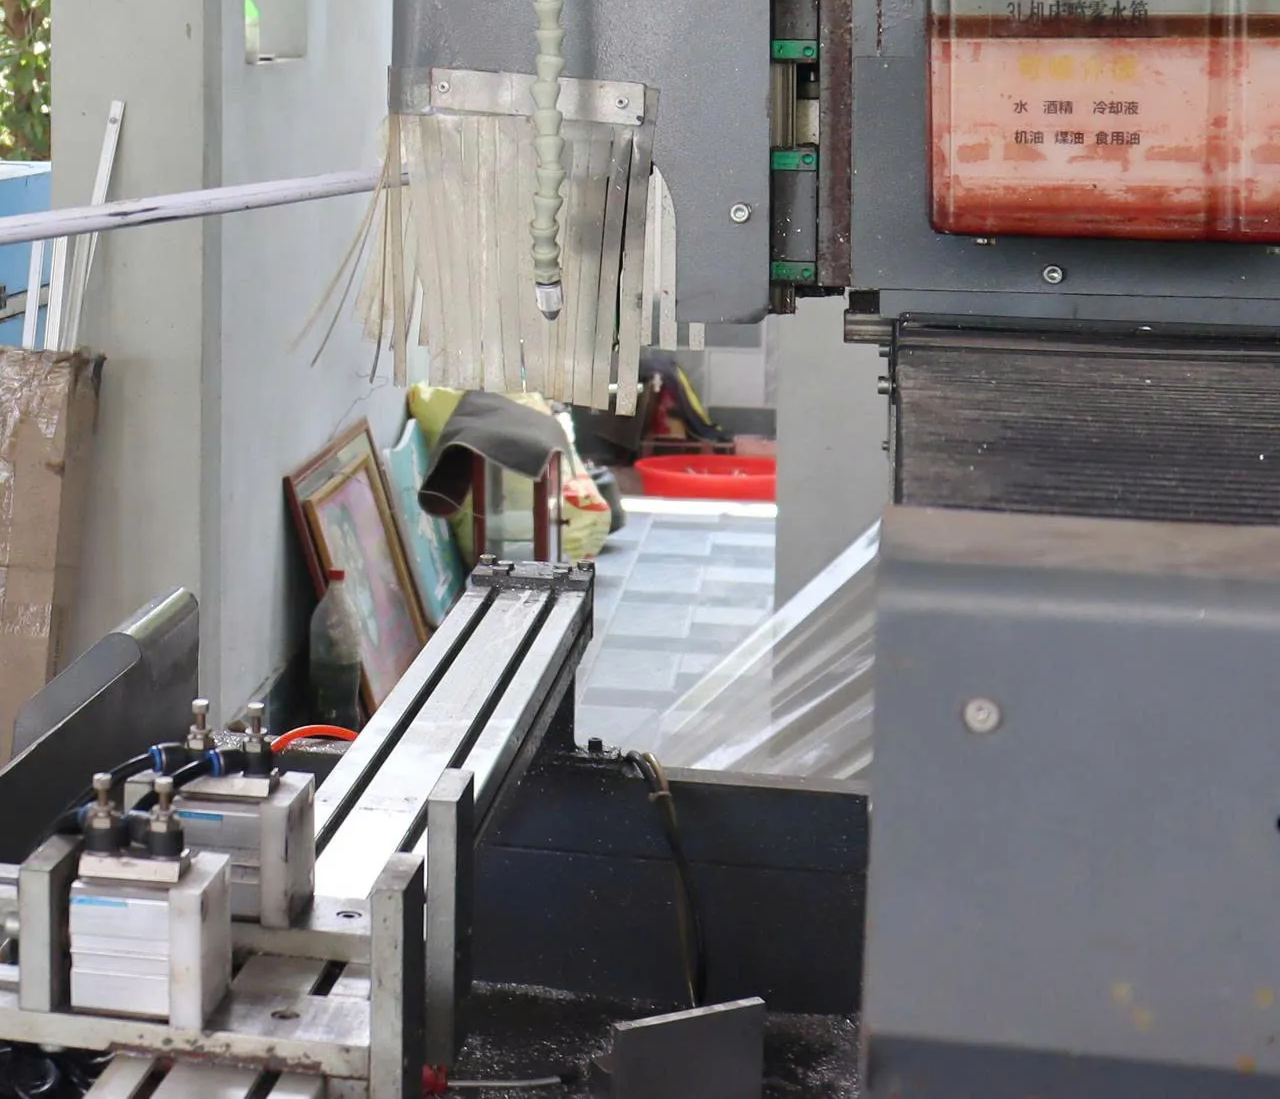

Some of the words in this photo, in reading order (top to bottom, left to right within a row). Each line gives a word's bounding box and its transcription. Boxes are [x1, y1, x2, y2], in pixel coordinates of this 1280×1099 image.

[1013, 100, 1028, 114] 水
[1043, 100, 1073, 115] 酒精
[1092, 100, 1139, 115] 冷却液
[1014, 130, 1044, 144] 机油
[1095, 130, 1140, 145] 食用油
